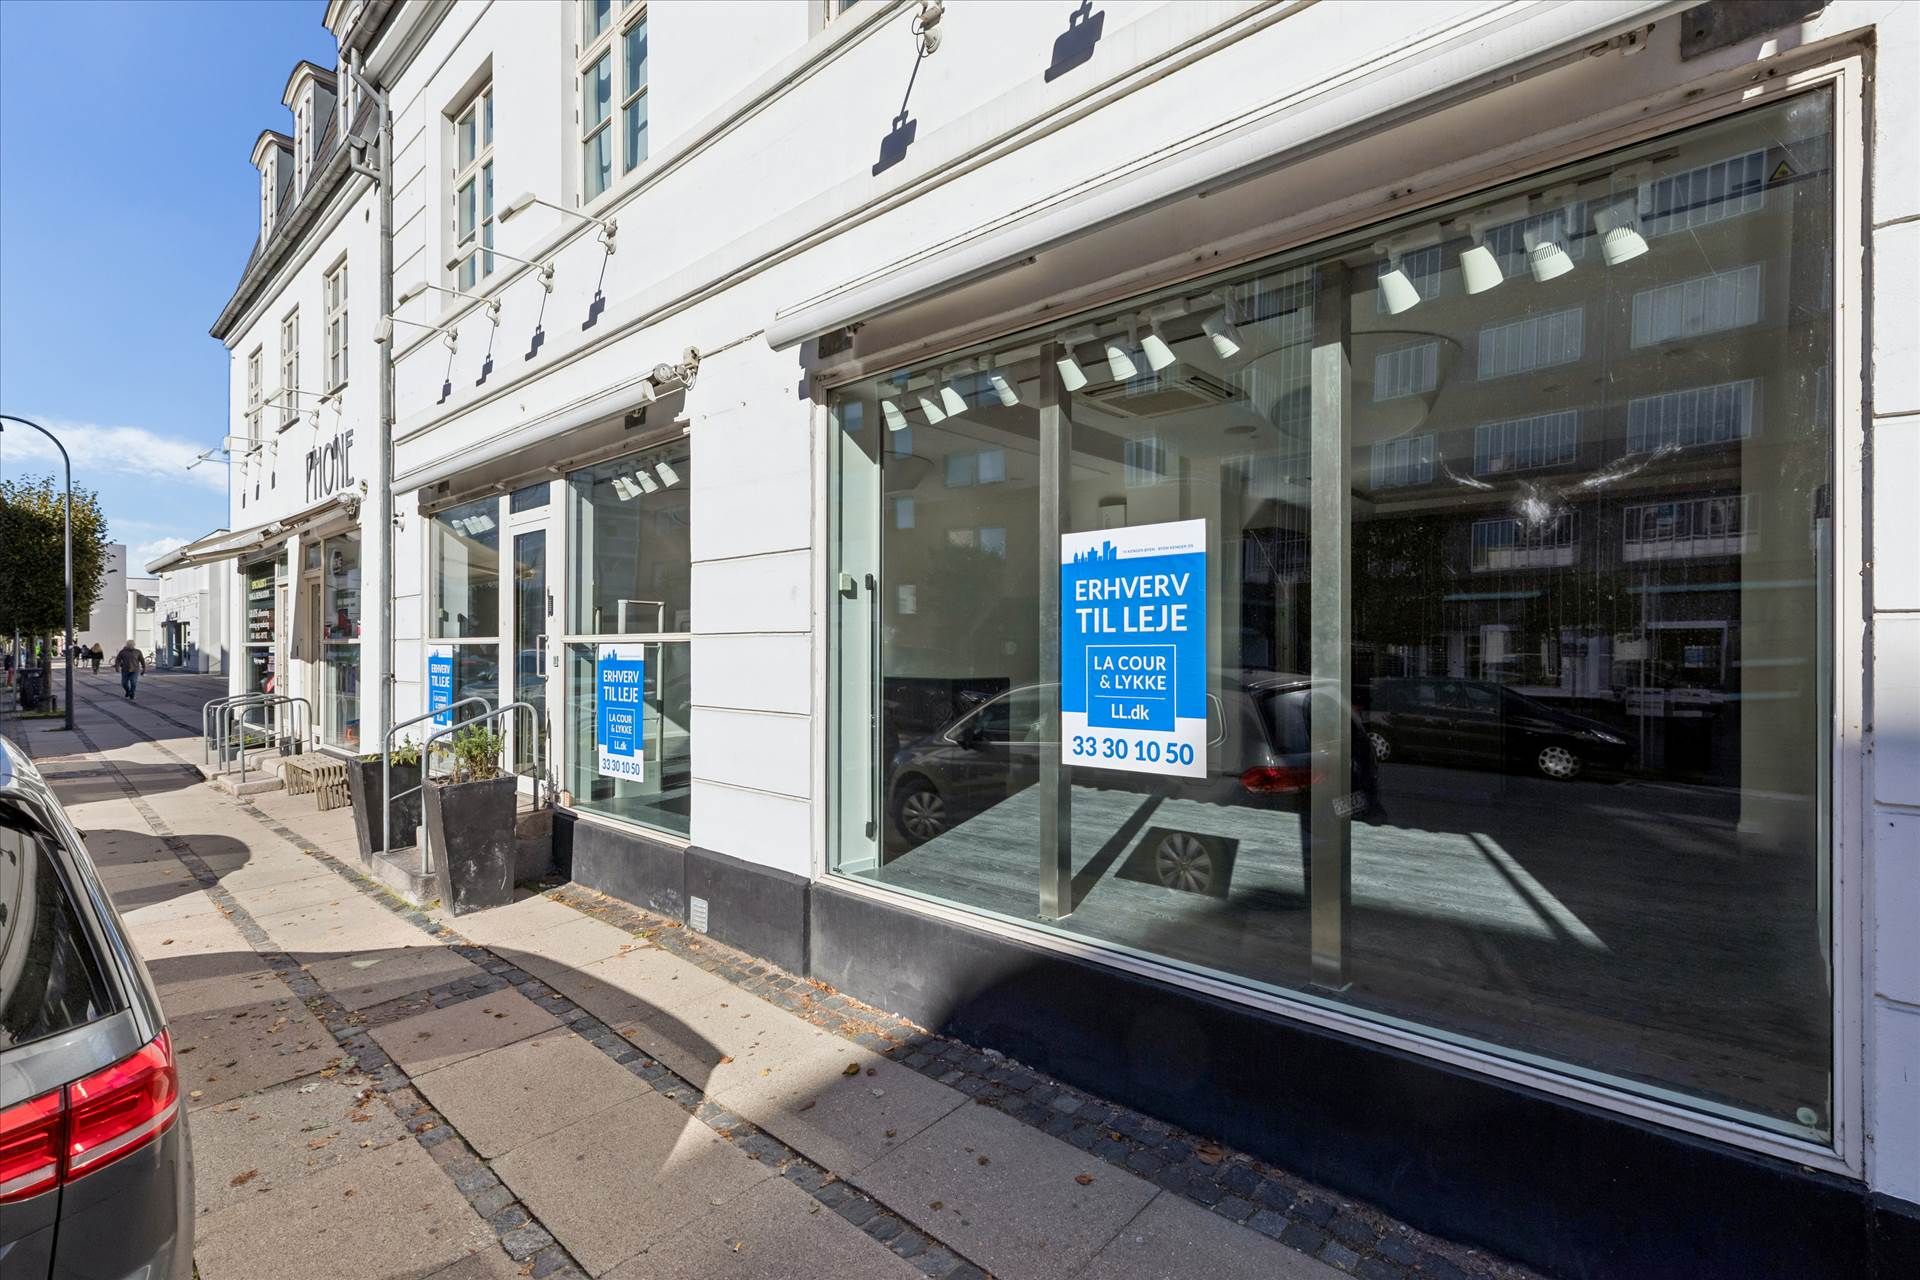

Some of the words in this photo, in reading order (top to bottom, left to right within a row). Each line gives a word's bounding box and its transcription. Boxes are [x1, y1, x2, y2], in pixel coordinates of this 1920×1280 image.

[306, 429, 354, 504] PHONE
[1075, 573, 1190, 602] ERHVERV
[1075, 607, 1117, 634] TIL
[1123, 604, 1188, 633] LEJE
[1094, 656, 1114, 671] LA
[1118, 656, 1167, 671] COUR
[603, 669, 639, 683] ERHVERV
[1100, 674, 1110, 689] &
[1115, 675, 1167, 690] LYKKE
[603, 686, 617, 702] TIL
[618, 687, 639, 703] LEJE
[617, 714, 632, 724] COUR
[1111, 703, 1150, 721] LL.dk
[1072, 736, 1097, 757] 33
[1102, 737, 1128, 760] 30
[1135, 740, 1161, 763] 10
[1165, 742, 1195, 766] 50
[602, 758, 611, 770] 33
[611, 760, 620, 772] 30
[621, 761, 630, 774] 10
[631, 763, 640, 776] 50
